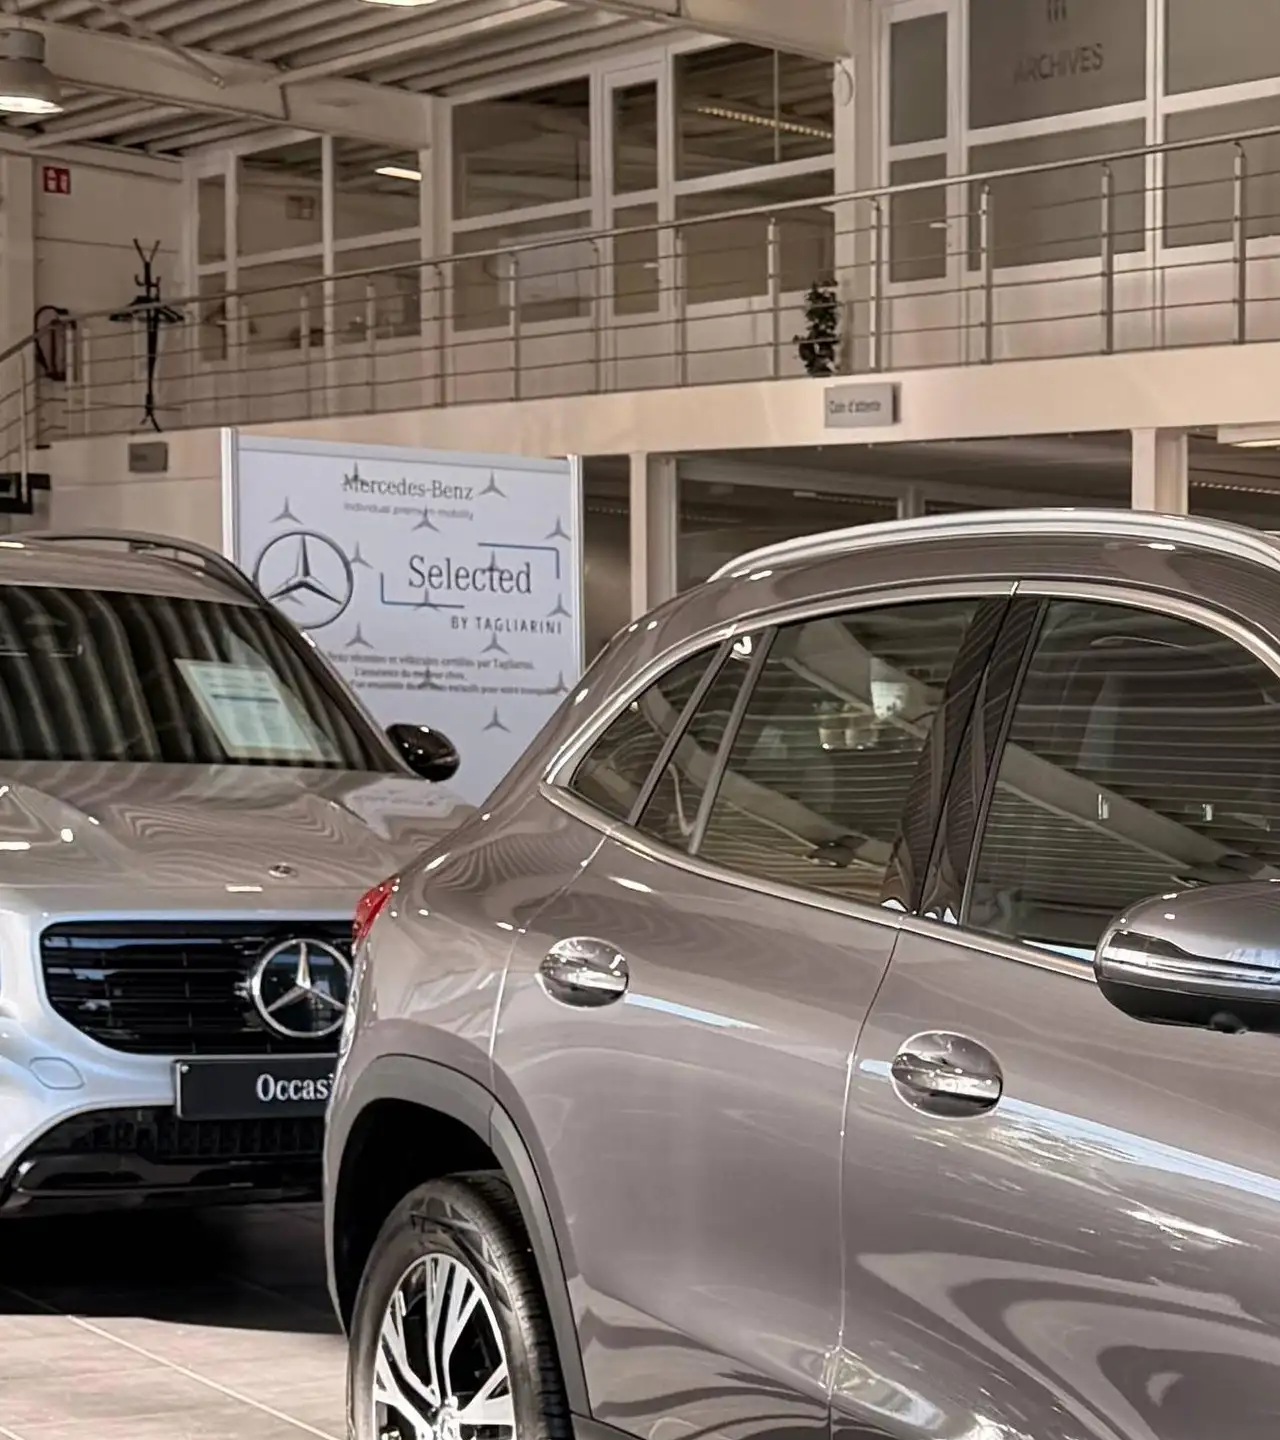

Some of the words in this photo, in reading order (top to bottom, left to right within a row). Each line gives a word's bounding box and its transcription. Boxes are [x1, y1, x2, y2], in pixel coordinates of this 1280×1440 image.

[1013, 43, 1104, 85] ARCHIVES
[343, 474, 474, 500] Mercedes-Benz
[408, 554, 532, 594] Selected
[451, 615, 468, 630] BY
[475, 616, 562, 635] TAGLIARINI
